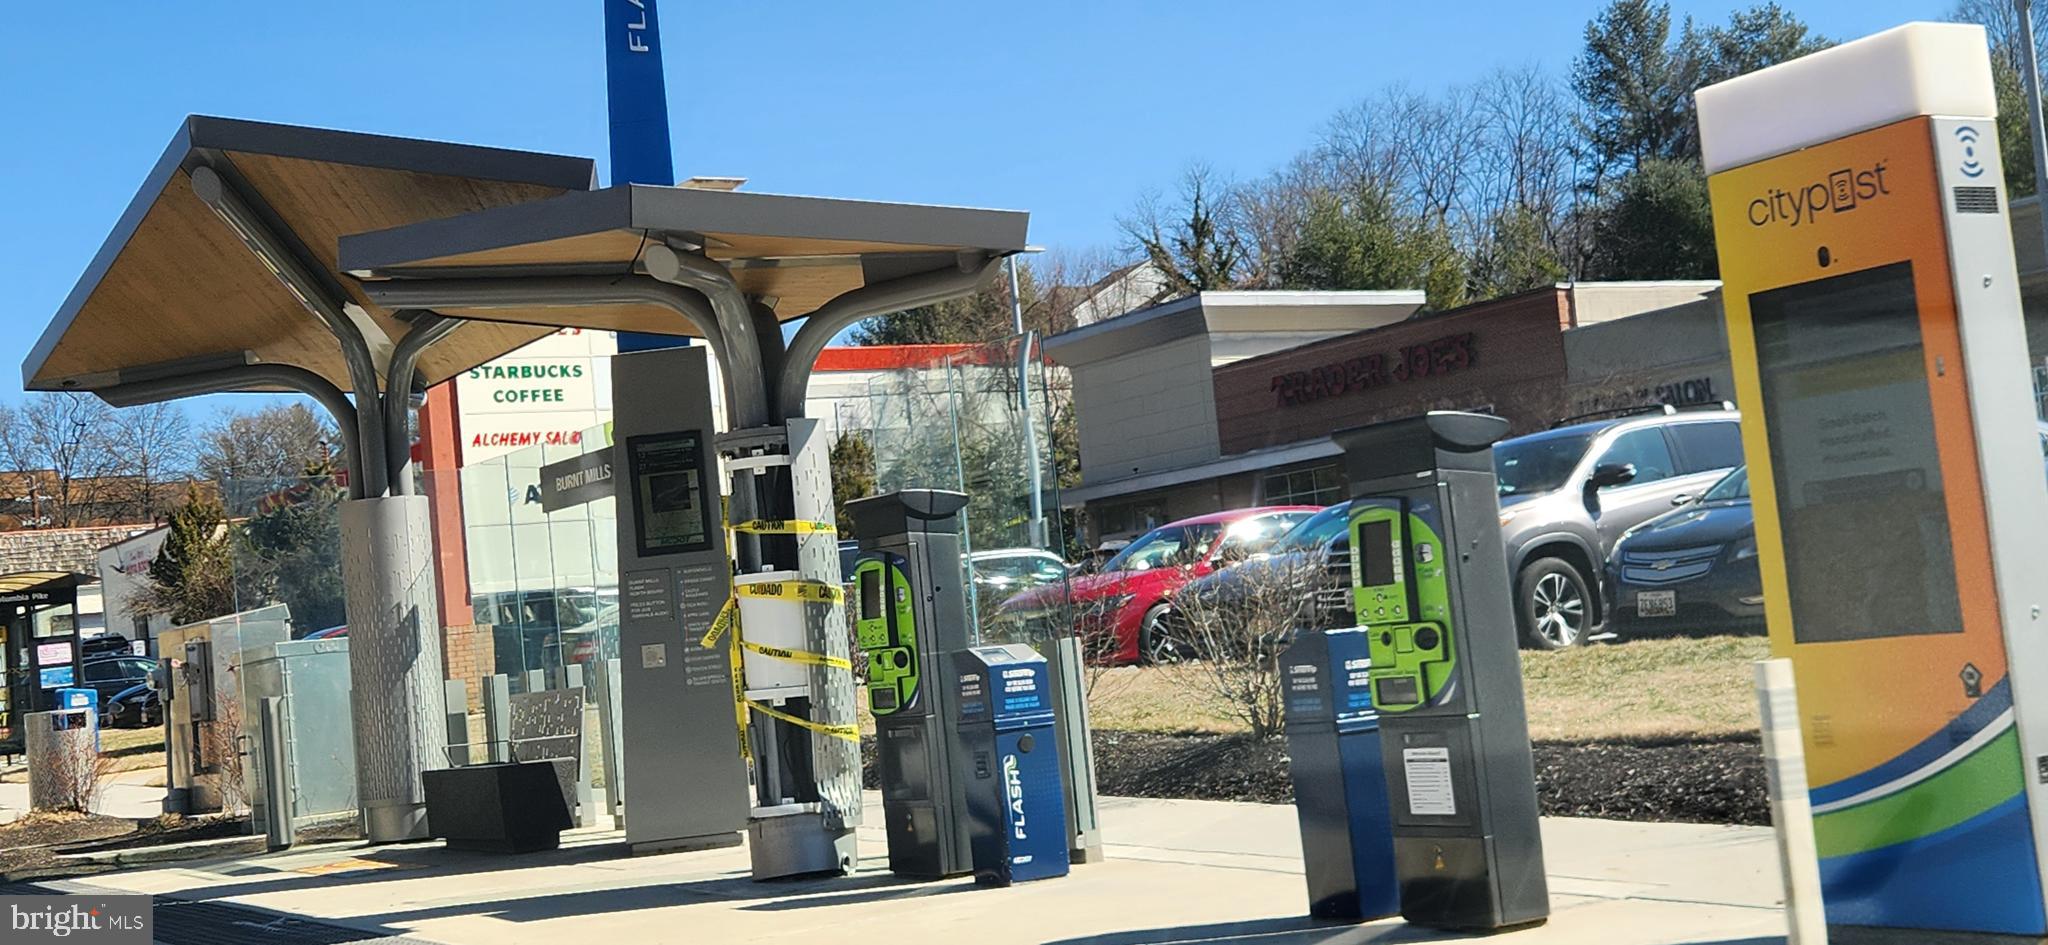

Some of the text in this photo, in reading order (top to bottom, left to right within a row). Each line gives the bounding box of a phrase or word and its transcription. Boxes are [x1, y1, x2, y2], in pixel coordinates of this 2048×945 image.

[469, 364, 583, 380] STARBUCKS
[1269, 353, 1387, 408] TRADER
[492, 388, 565, 404] COFFEE
[472, 431, 541, 448] ALCHEMY
[555, 463, 612, 492] BURNT MILLS
[751, 520, 785, 531] CAUTION
[749, 583, 783, 597] CUIDADO
[758, 645, 793, 659] CAUTION
[1008, 769, 1027, 840] FLASH
